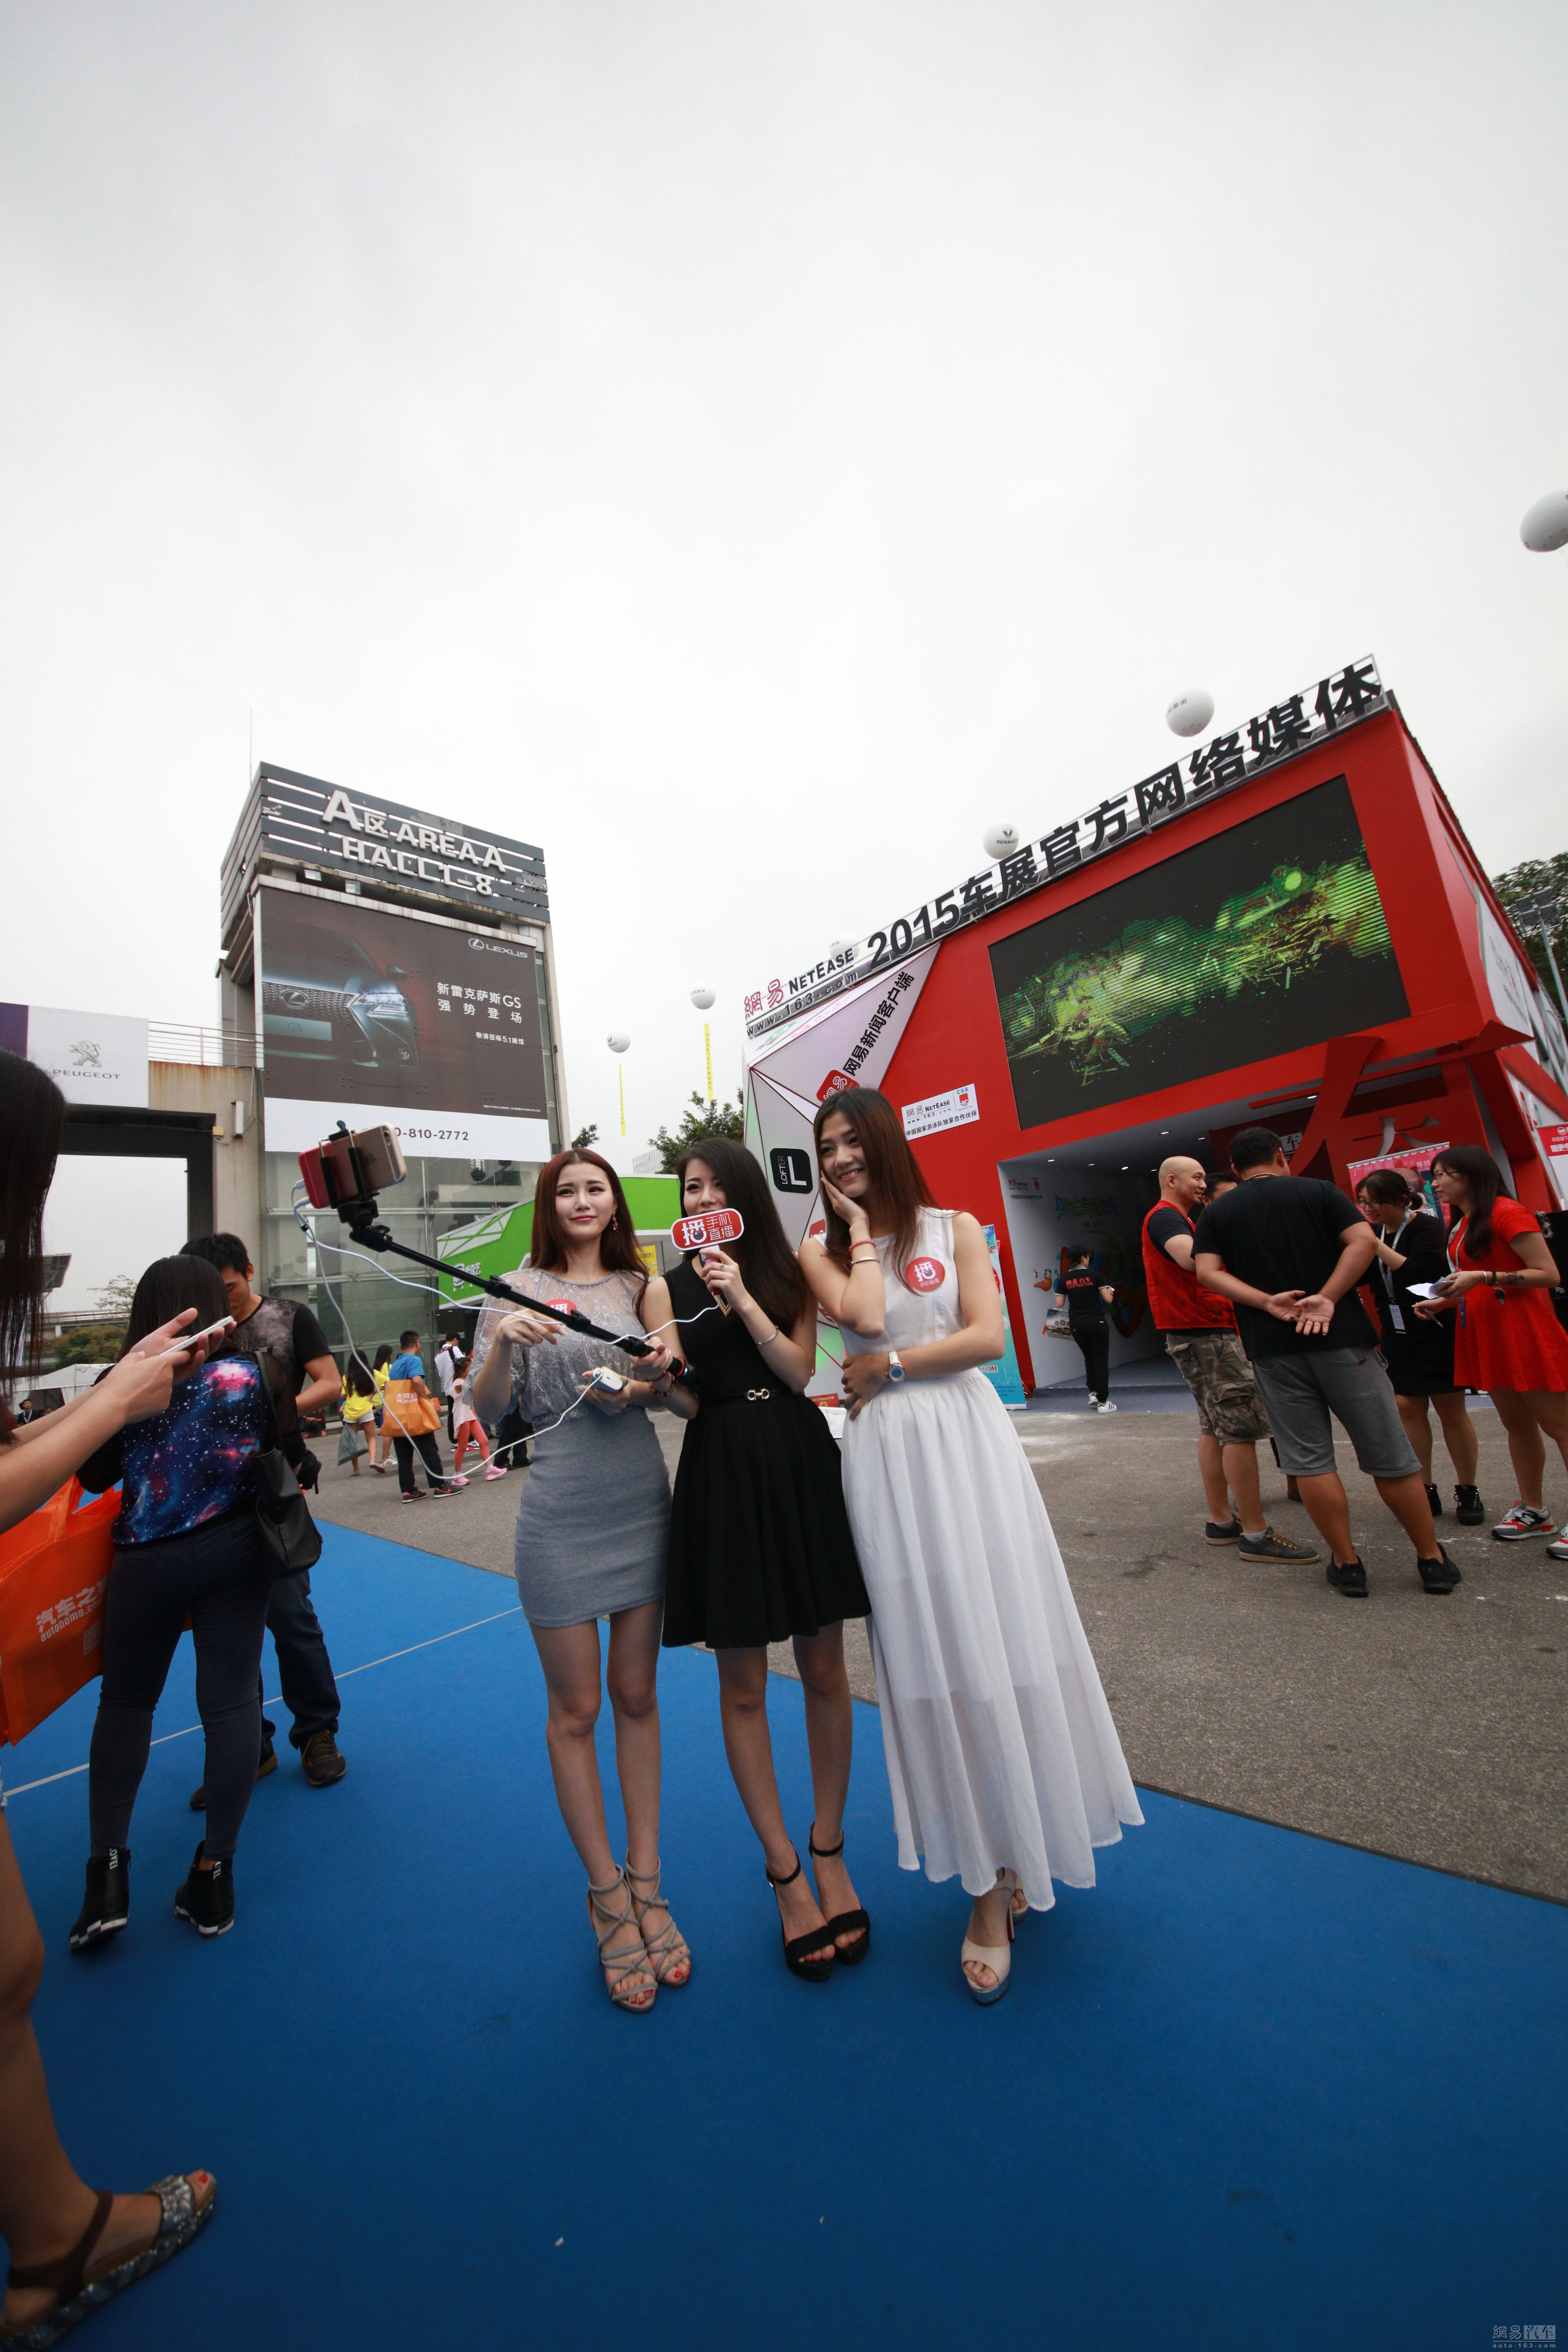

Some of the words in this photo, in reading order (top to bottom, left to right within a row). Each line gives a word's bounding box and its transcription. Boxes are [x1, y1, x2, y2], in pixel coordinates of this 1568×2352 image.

[867, 663, 1382, 971] 2015车展官方网络媒体
[342, 836, 436, 882] HALL
[396, 823, 479, 865] AREA
[482, 846, 506, 873] A
[486, 944, 528, 958] LEXUS
[437, 982, 522, 1008] 新雷克萨斯GS
[842, 971, 915, 1076] 网易新闻客户端
[53, 1069, 120, 1080] PEUGEOT
[956, 1087, 969, 1095] CSA
[906, 1110, 977, 1136] 中国国家游泳队独家合作伙伴
[777, 1155, 788, 1185] LOFTER
[706, 1212, 732, 1229] 手机
[708, 1224, 734, 1241] 直播
